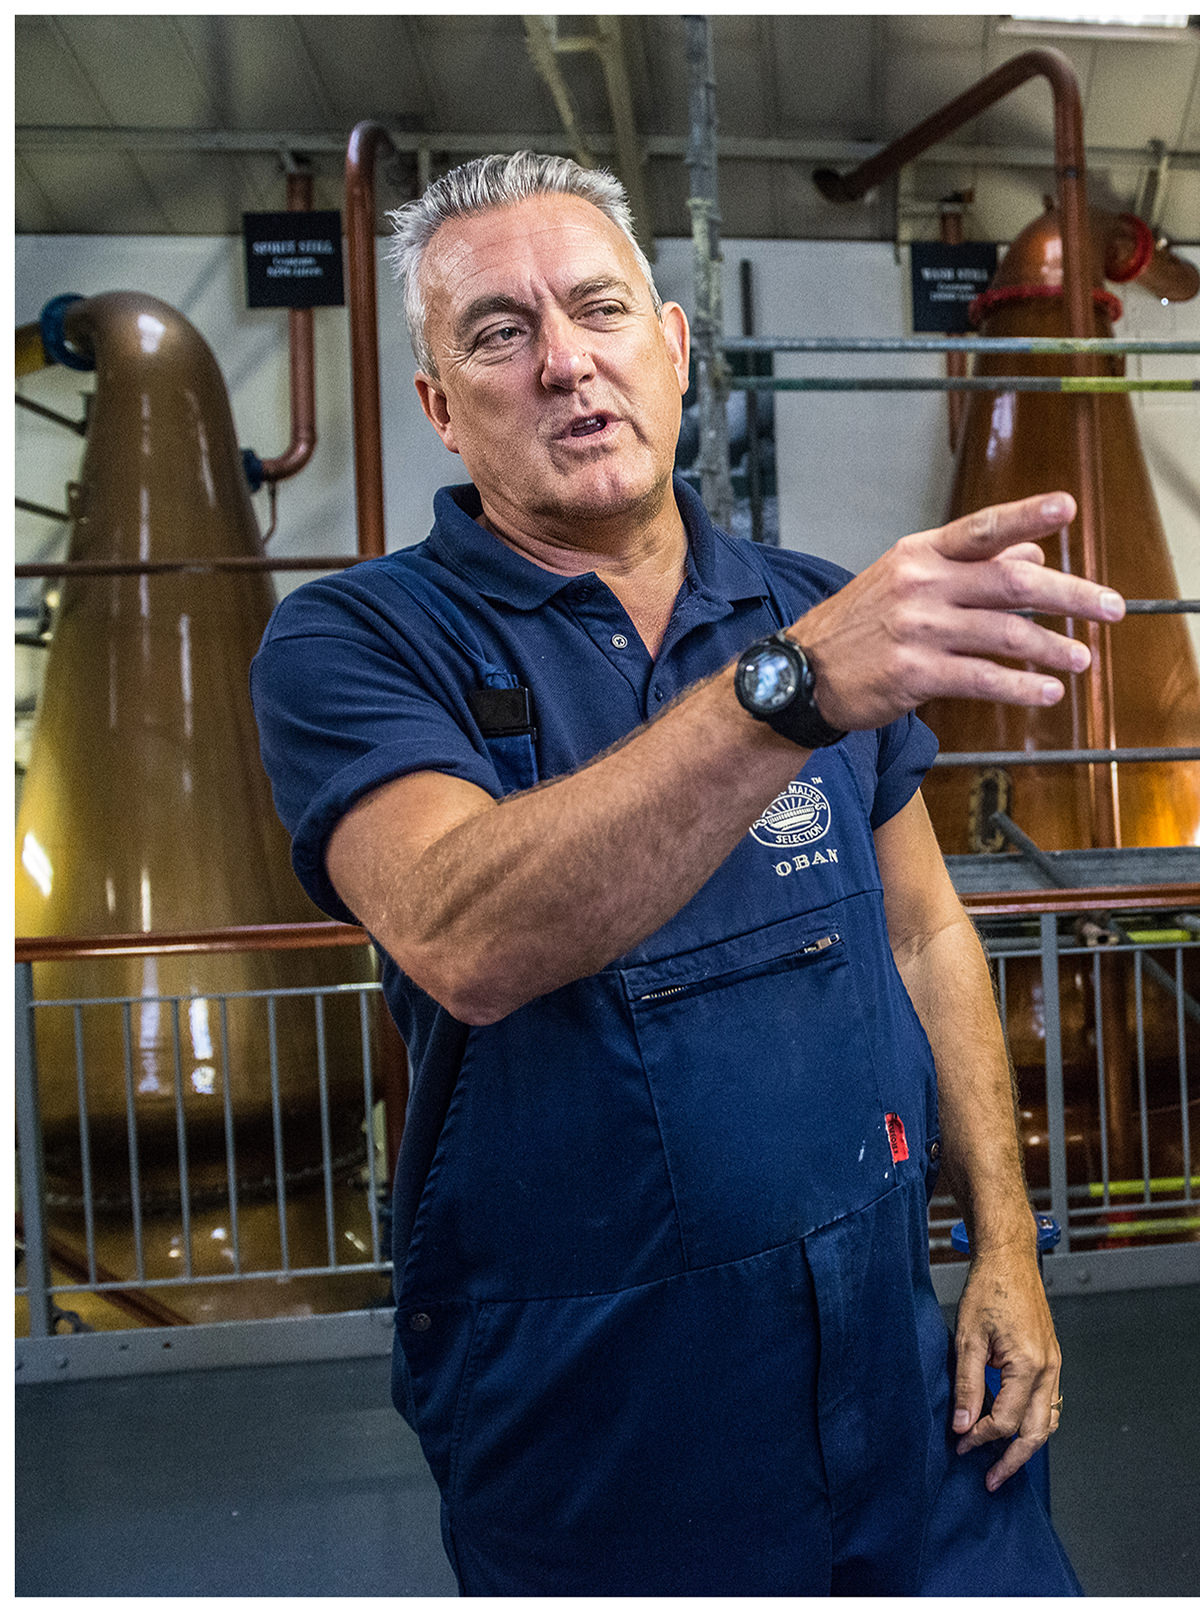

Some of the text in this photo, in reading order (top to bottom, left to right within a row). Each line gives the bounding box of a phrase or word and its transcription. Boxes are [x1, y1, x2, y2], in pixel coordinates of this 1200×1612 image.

[788, 785, 821, 802] MALTS
[775, 823, 824, 844] SELECTION
[775, 848, 839, 877] OBAN
